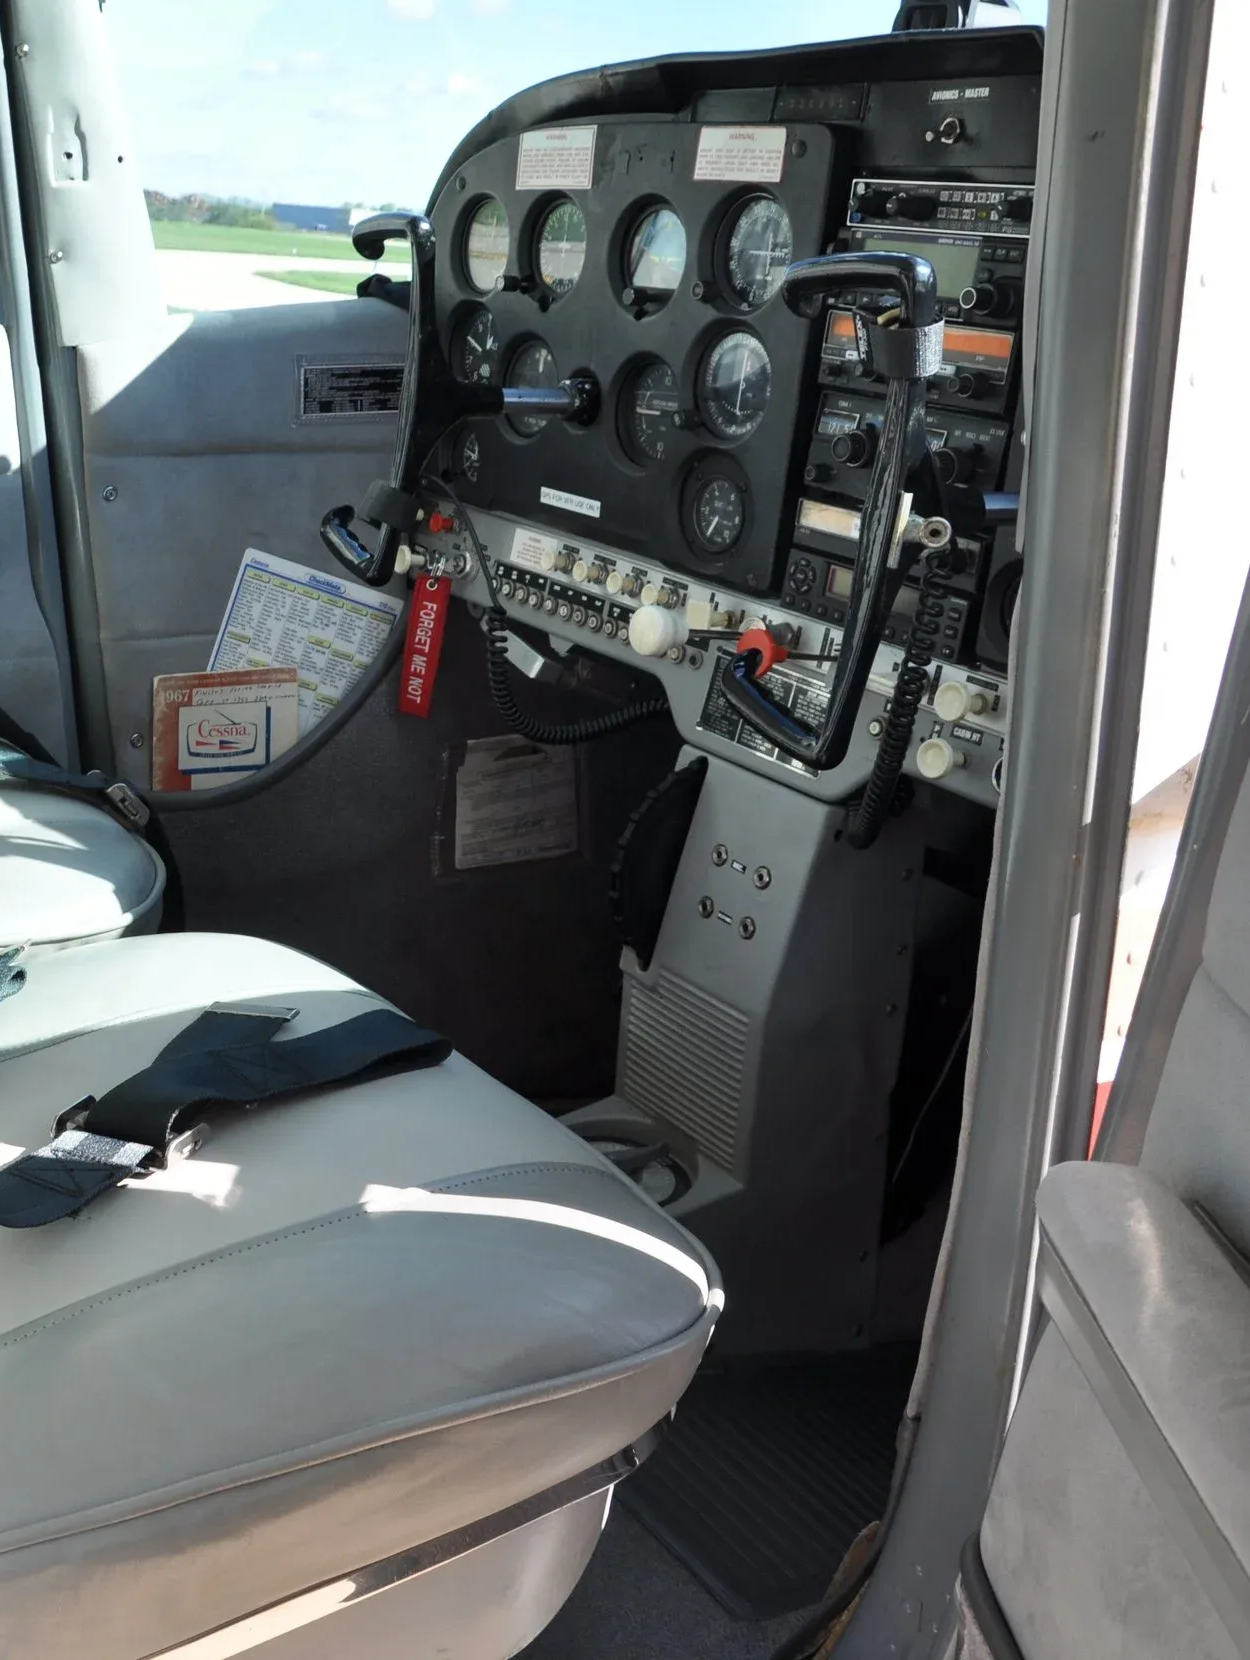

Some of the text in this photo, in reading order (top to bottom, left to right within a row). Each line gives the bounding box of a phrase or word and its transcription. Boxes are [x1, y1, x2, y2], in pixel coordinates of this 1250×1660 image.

[932, 89, 959, 101] AVIONICS
[964, 87, 990, 99] MASTER
[307, 575, 342, 592] CheckMate
[406, 601, 438, 704] FORGET ME NOT
[160, 689, 190, 704] 1967
[197, 718, 247, 739] Cessna
